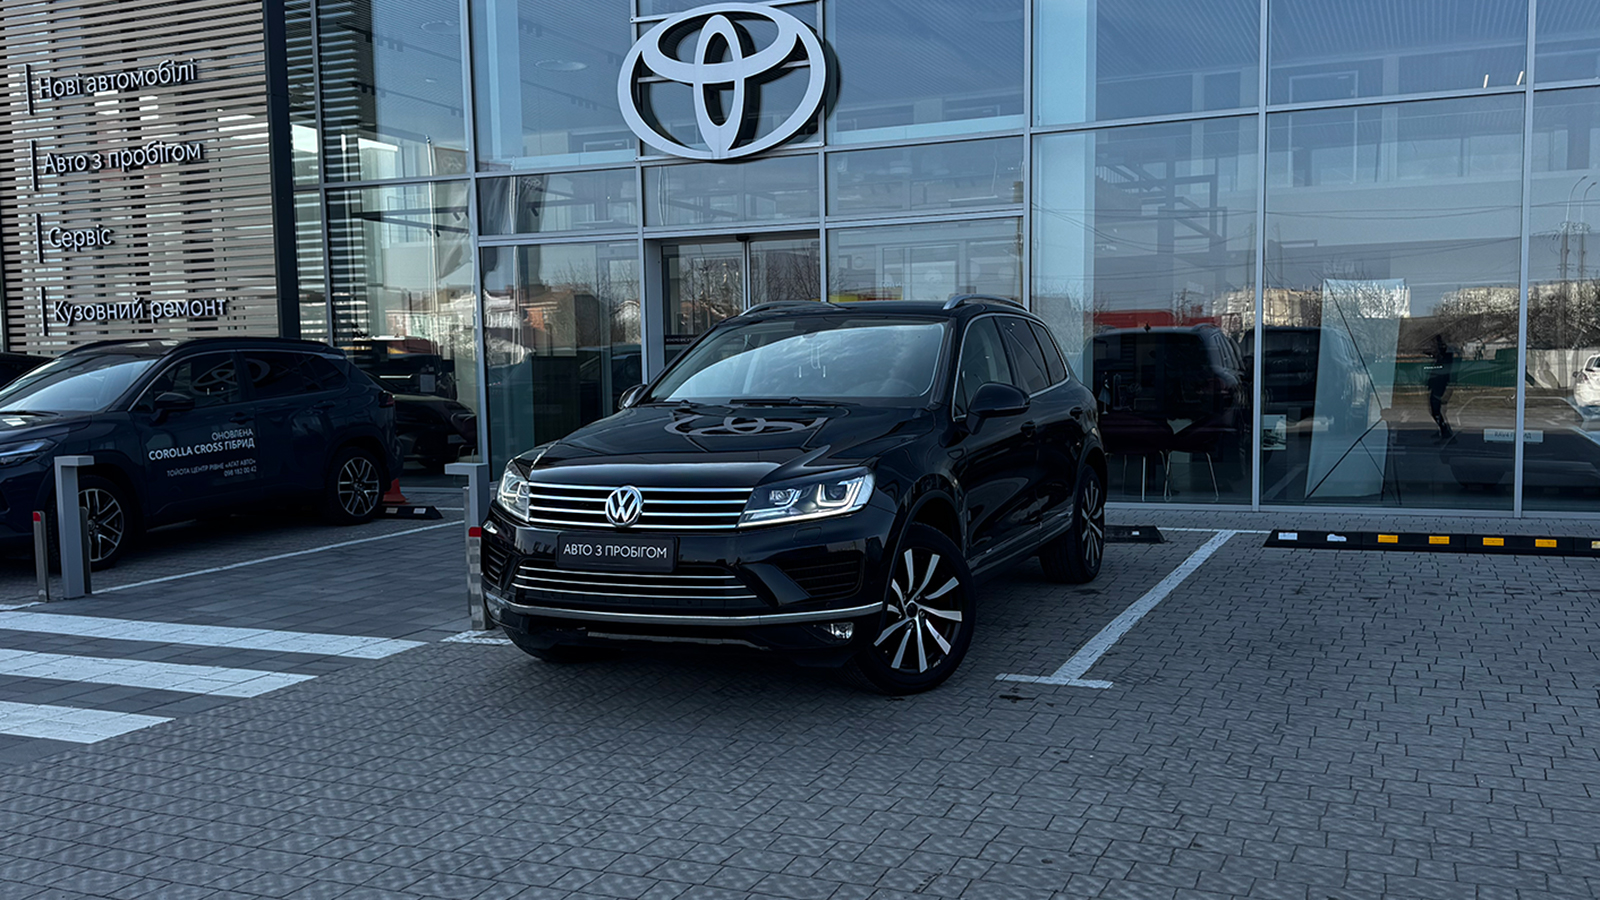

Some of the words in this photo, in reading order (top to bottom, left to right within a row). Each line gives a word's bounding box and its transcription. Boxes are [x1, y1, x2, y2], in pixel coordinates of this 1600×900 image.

[39, 73, 81, 98] Нові
[86, 58, 195, 92] автомобілі
[44, 152, 87, 174] Авто
[92, 154, 102, 170] з
[108, 141, 203, 171] пробігом
[49, 224, 112, 251] Сервіс
[53, 298, 144, 325] Кузовний
[150, 298, 228, 323] ремонт
[211, 428, 254, 441] ОНОВЛЕНА
[148, 446, 193, 460] COROLLA
[194, 442, 224, 455] CROSS
[563, 543, 593, 556] АВТО
[605, 545, 667, 559] ПРОБІГОМ
